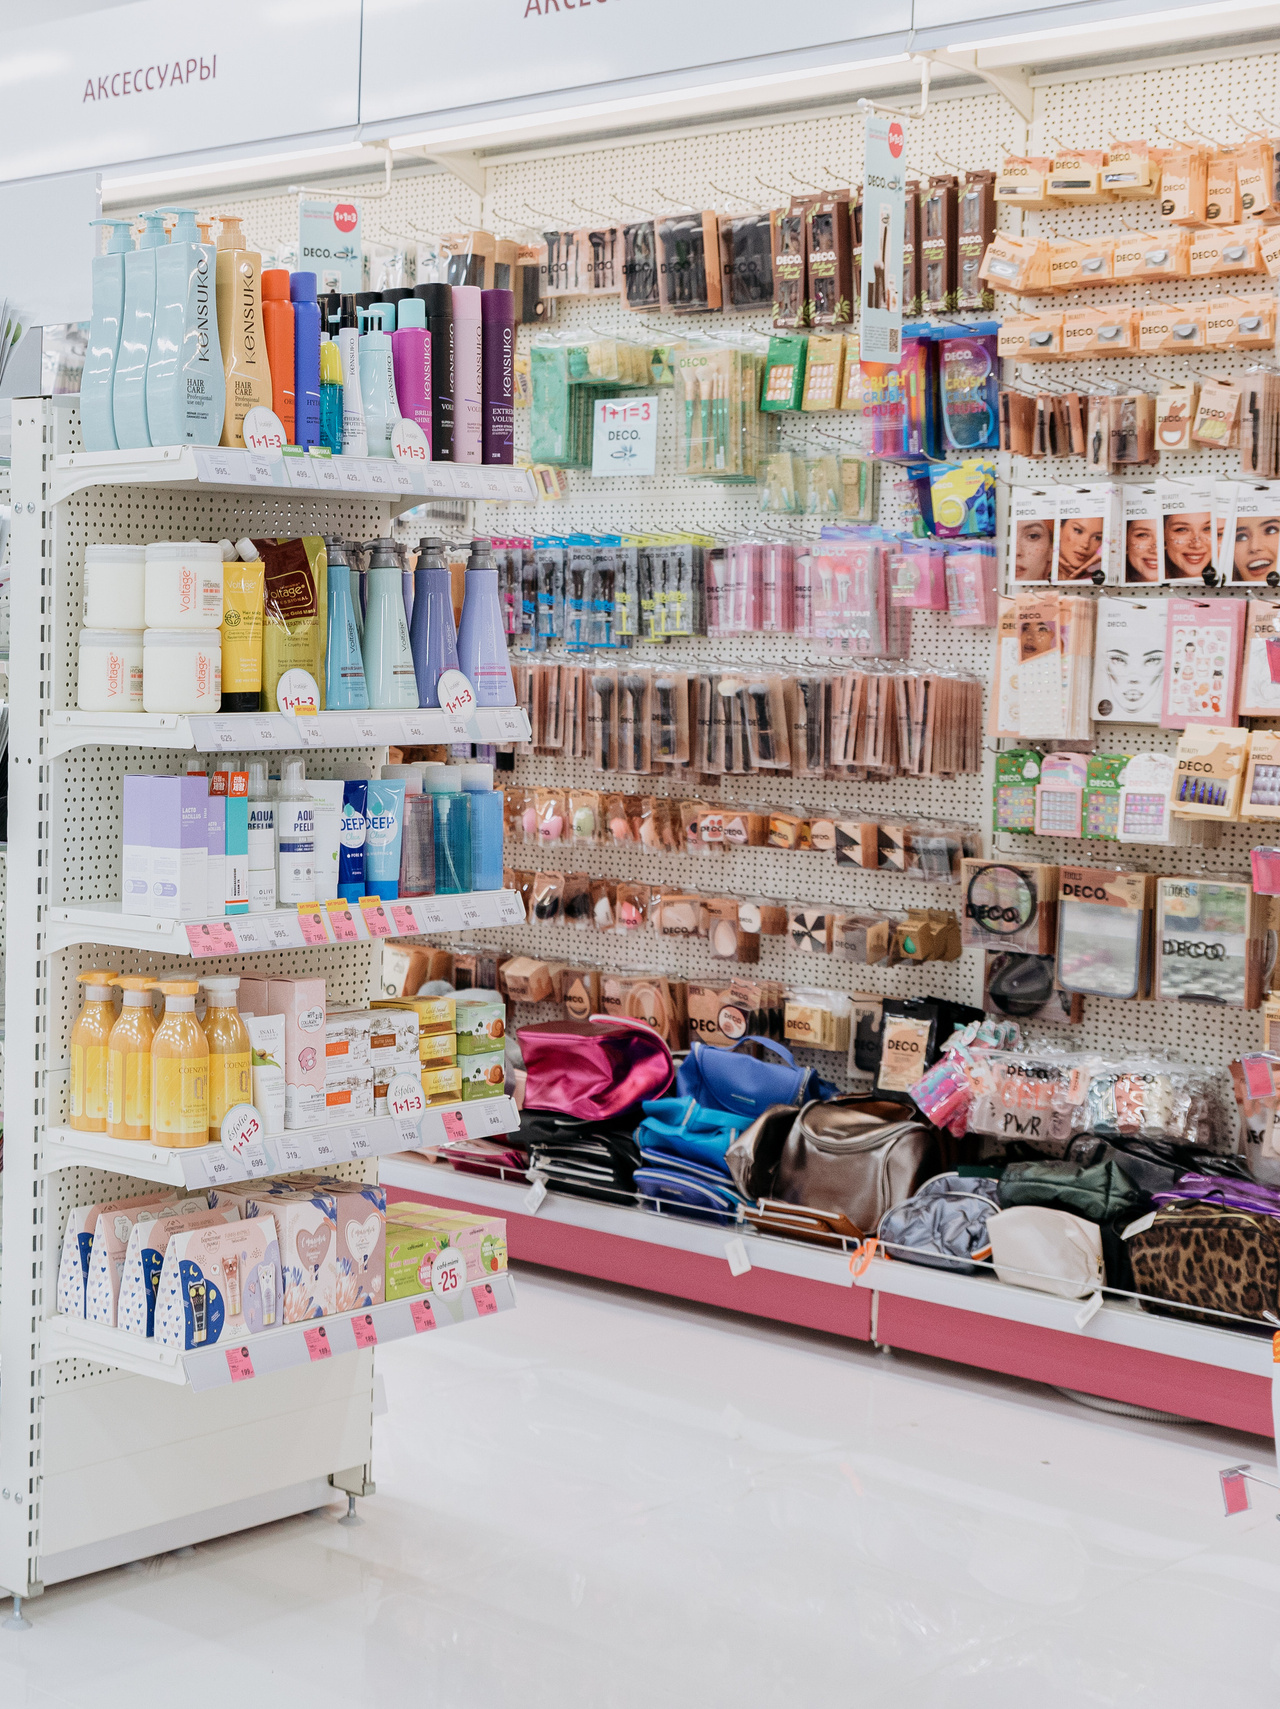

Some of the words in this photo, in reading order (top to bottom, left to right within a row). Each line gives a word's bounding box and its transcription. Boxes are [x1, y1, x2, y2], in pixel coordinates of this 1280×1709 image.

[83, 54, 218, 103] АКСЕССУАРЫ
[1110, 153, 1132, 162] DECO.
[1056, 161, 1082, 169] DECO.
[1003, 168, 1029, 177] DECO.
[1240, 176, 1262, 186] DECO.
[1163, 183, 1186, 192] DECO.
[1209, 187, 1233, 196] DECO.
[334, 209, 358, 223] 1+1=3
[776, 254, 802, 265] DECO.
[810, 251, 837, 263] DECO.
[1116, 252, 1142, 263] DECO.
[1192, 250, 1220, 261] DECO.
[1052, 260, 1079, 271] DECO.
[1141, 325, 1170, 334] DECO.
[1208, 319, 1236, 329] DECO.
[1066, 328, 1095, 338] DECO.
[1001, 335, 1027, 345] DECO.
[944, 351, 973, 362] DECO.
[187, 378, 205, 388] HAIR
[235, 381, 252, 390] HAIR
[862, 375, 906, 389] CRUSH
[187, 386, 206, 395] CARE
[235, 388, 253, 397] CARE
[862, 389, 906, 404] CRUSH
[600, 402, 651, 423] 1+1=3
[862, 403, 906, 418] CRUSH
[608, 430, 641, 441] DECO.
[249, 434, 282, 449] 1+1=3
[396, 444, 426, 460] 1+1=3
[813, 547, 847, 557] DECO.
[816, 628, 870, 639] SONYA
[446, 688, 472, 713] 1+1=3
[1178, 760, 1215, 774] DECO.
[1089, 779, 1116, 788] DECO.
[250, 810, 273, 822] AQUA
[1063, 883, 1109, 901] DECO.
[690, 1018, 719, 1032] DEC
[787, 1020, 812, 1031] DECO.
[888, 1039, 921, 1053] DECO.
[393, 1096, 422, 1114] 1+1=3
[1004, 1114, 1042, 1136] PWR
